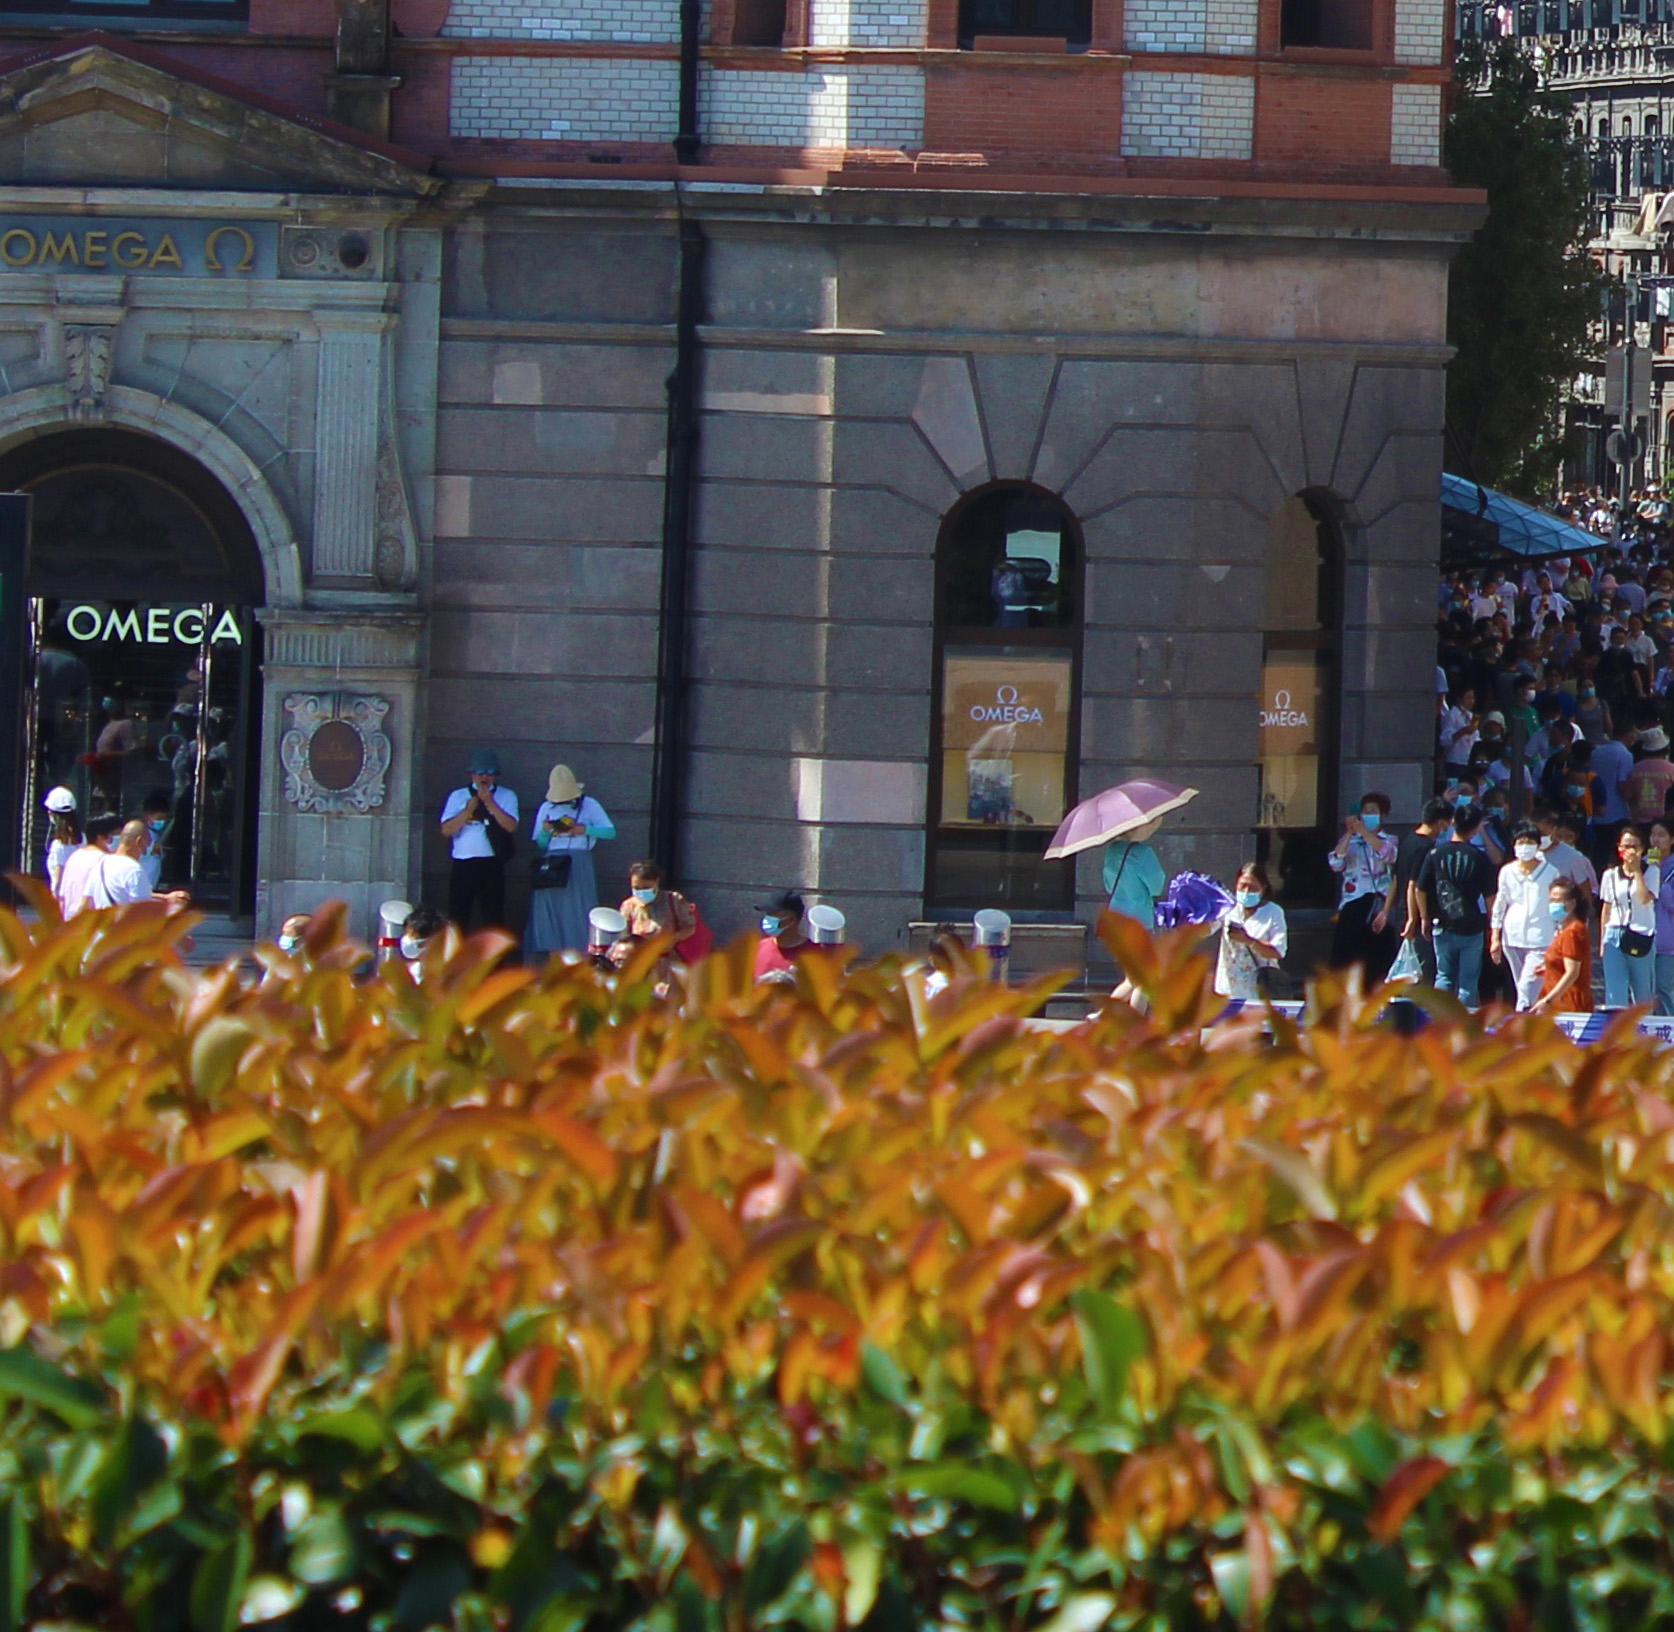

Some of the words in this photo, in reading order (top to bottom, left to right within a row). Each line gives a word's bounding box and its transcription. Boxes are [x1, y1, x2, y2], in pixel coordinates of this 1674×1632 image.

[1, 229, 183, 269] OMEGA
[66, 605, 242, 645] OMEGA
[970, 705, 1043, 723] OMEGA
